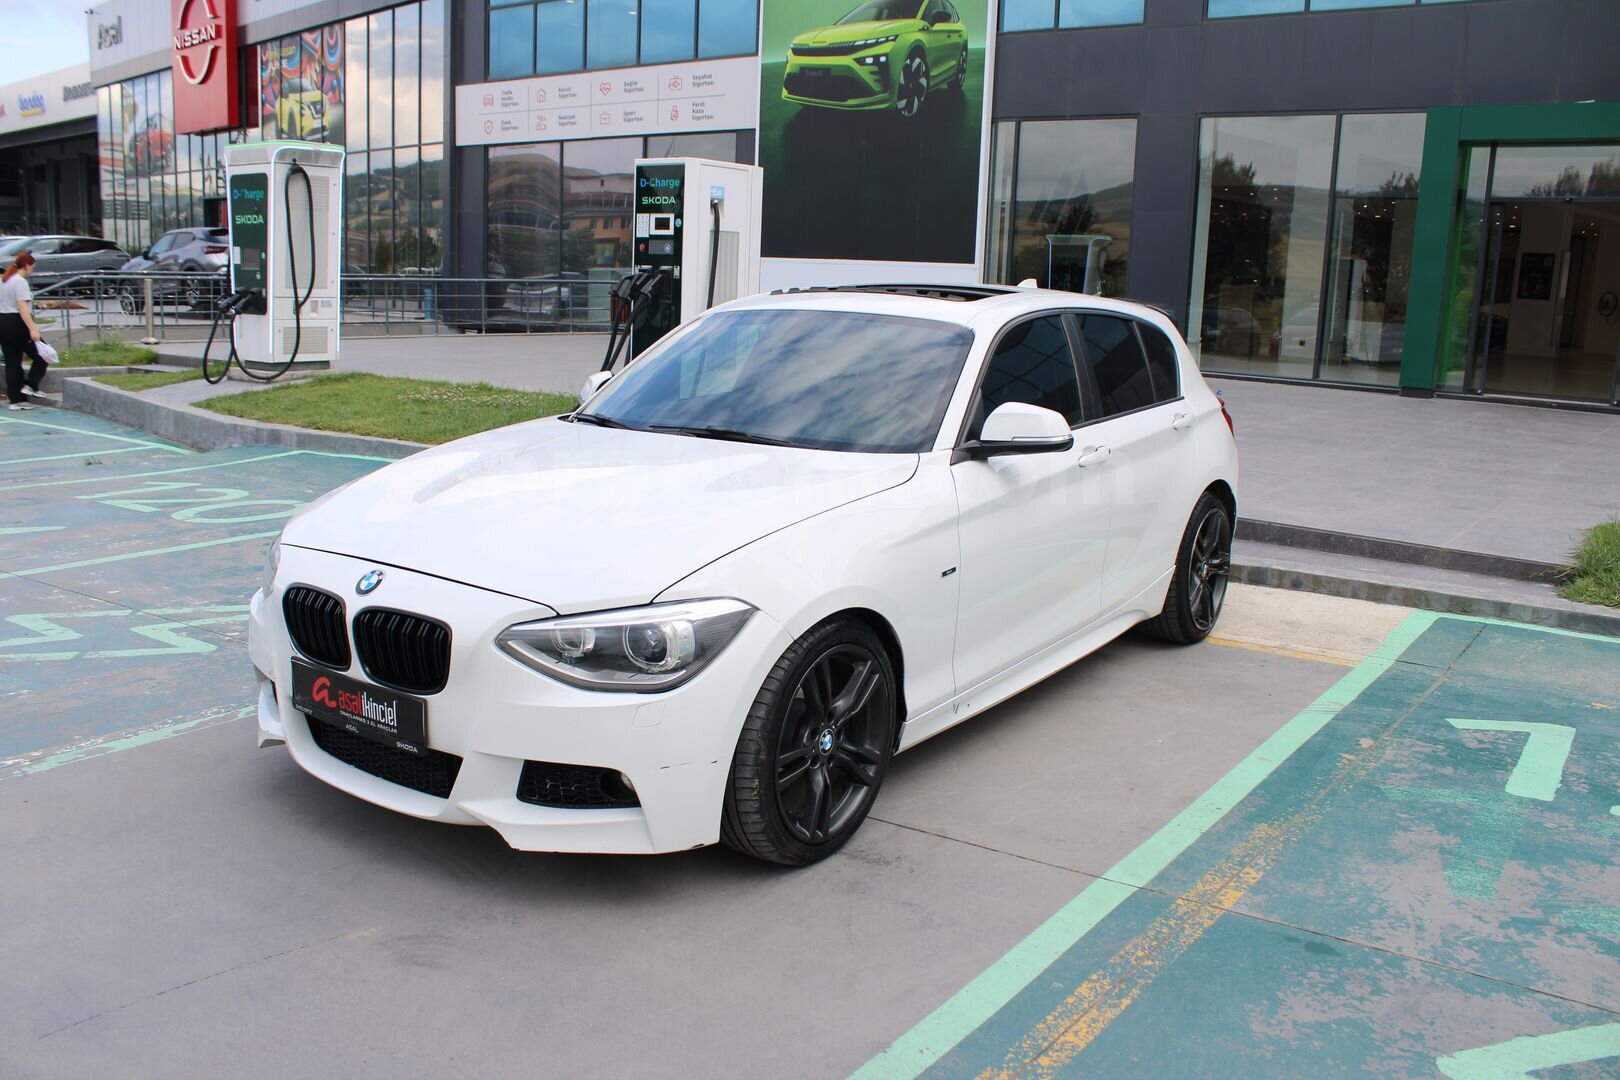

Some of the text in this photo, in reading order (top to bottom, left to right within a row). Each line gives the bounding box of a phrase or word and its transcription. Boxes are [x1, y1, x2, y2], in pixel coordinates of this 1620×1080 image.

[174, 24, 216, 50] NISSAN
[640, 178, 680, 189] D-Charge
[642, 196, 676, 205] SKODA
